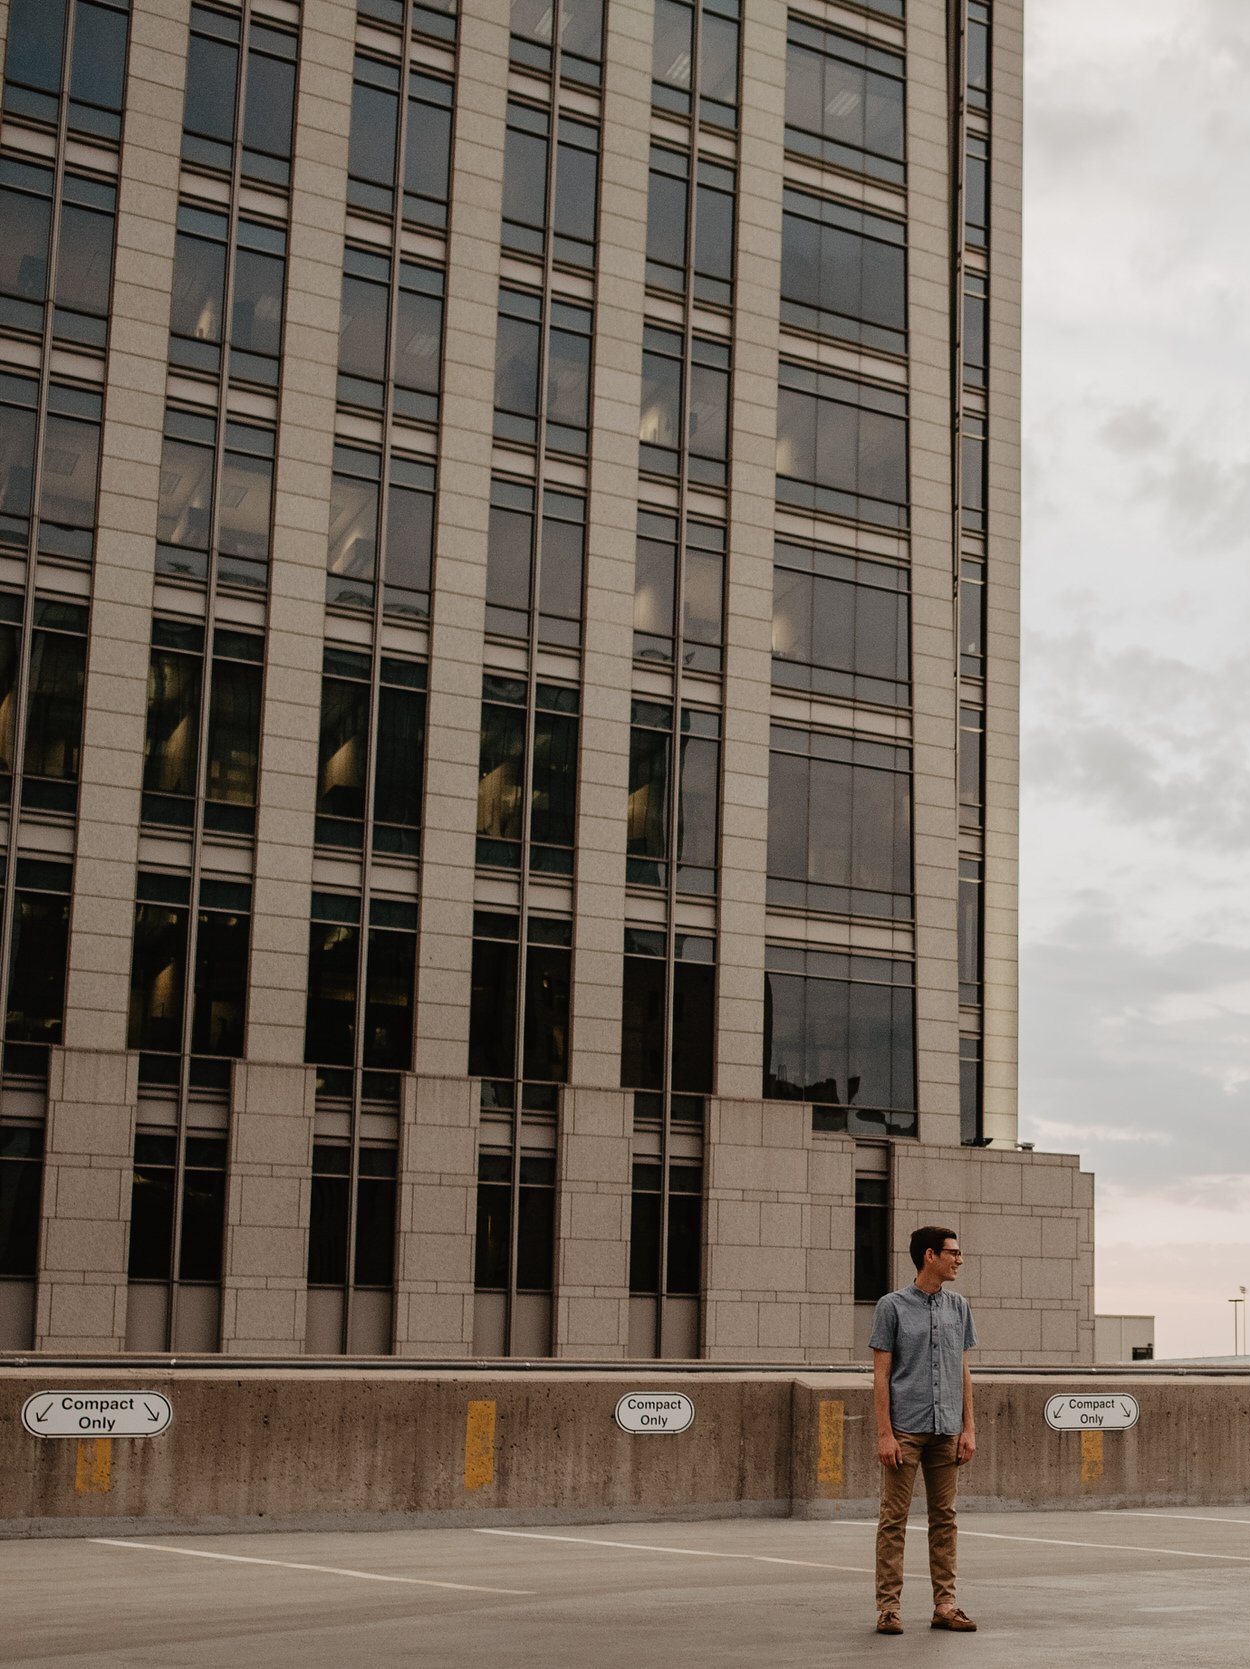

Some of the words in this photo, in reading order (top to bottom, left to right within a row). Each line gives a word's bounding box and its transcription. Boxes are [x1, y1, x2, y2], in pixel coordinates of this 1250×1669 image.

[61, 1397, 135, 1413] Compact
[627, 1398, 682, 1412] Compact
[1068, 1398, 1115, 1411] Compact
[78, 1416, 116, 1432] Only
[640, 1414, 668, 1428] Only
[1080, 1413, 1104, 1426] Only
